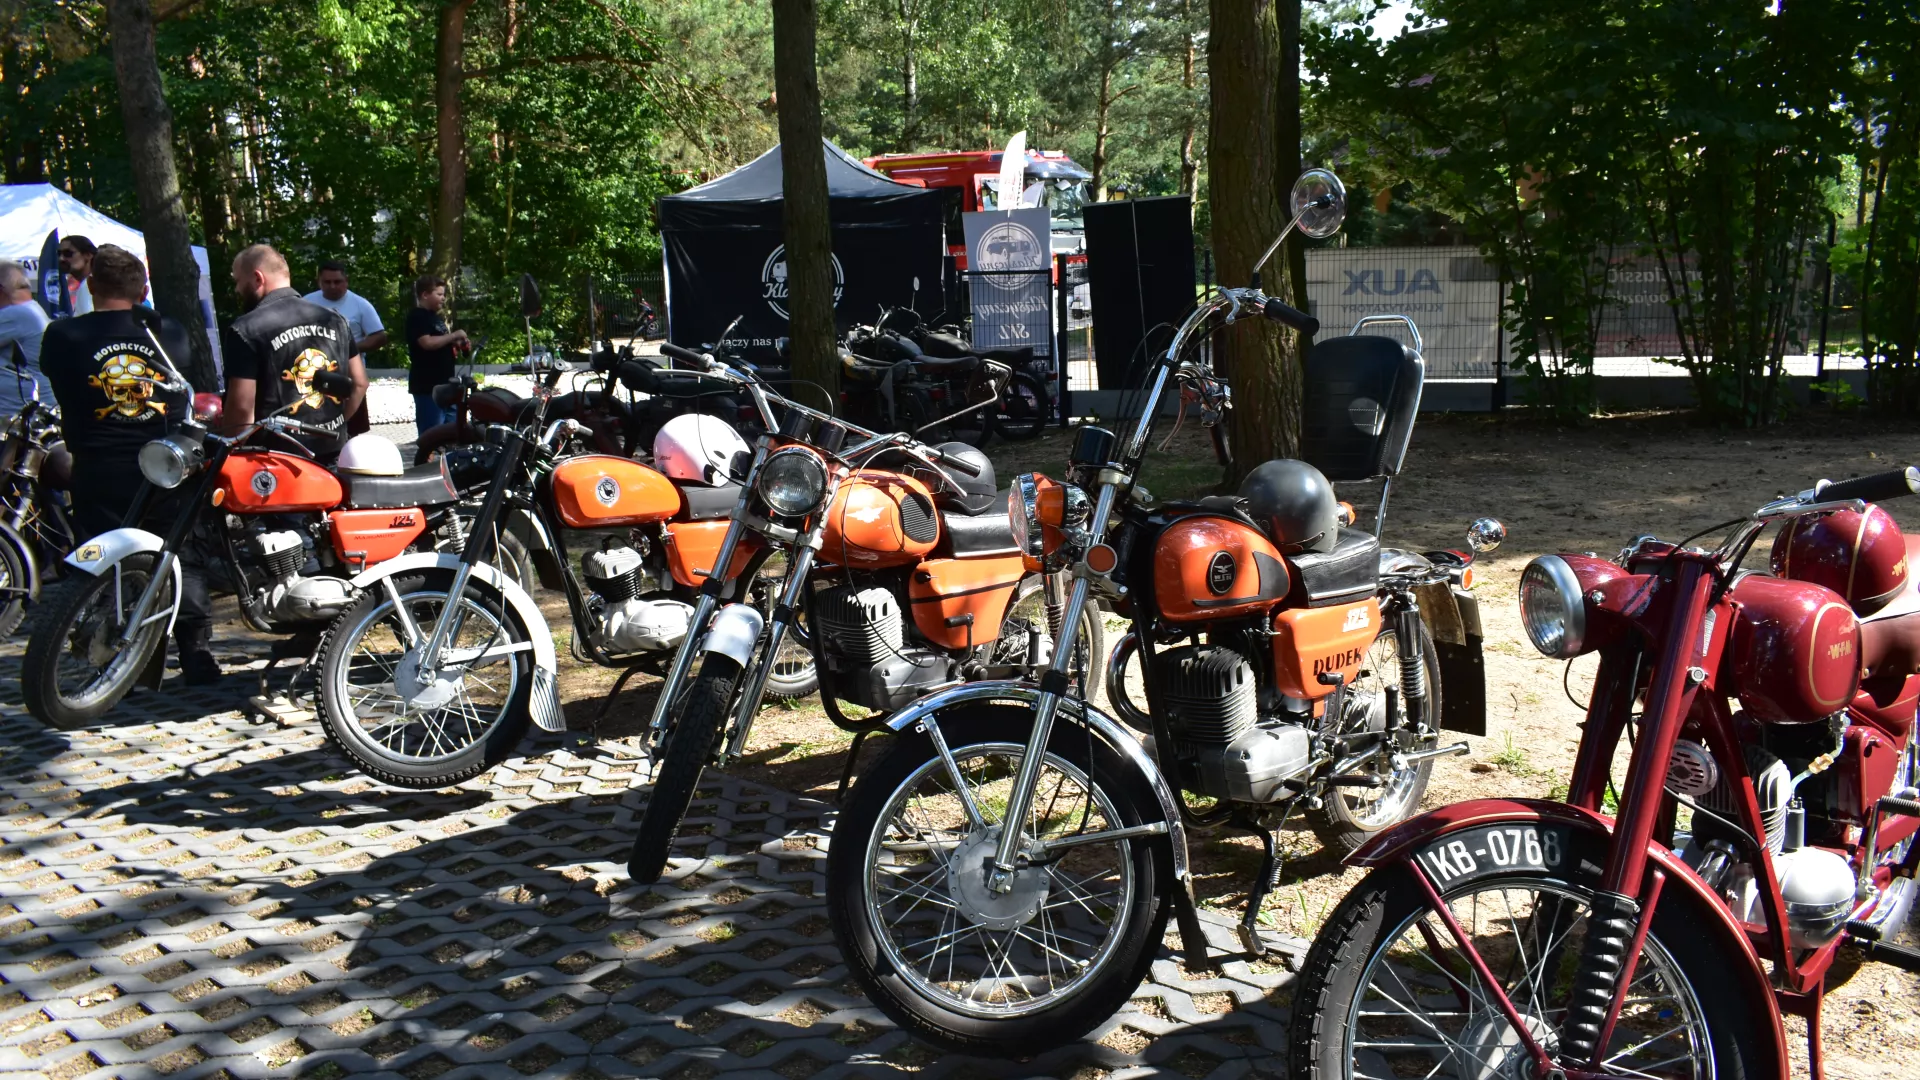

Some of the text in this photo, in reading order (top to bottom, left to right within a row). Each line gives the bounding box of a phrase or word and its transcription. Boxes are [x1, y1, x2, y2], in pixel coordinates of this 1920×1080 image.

[270, 324, 337, 351] MOTORCYCLE
[752, 338, 772, 346] nas
[93, 342, 156, 362] MOTORCYCLE
[1313, 647, 1363, 676] DUDEK
[1427, 829, 1561, 881] KB-0768
